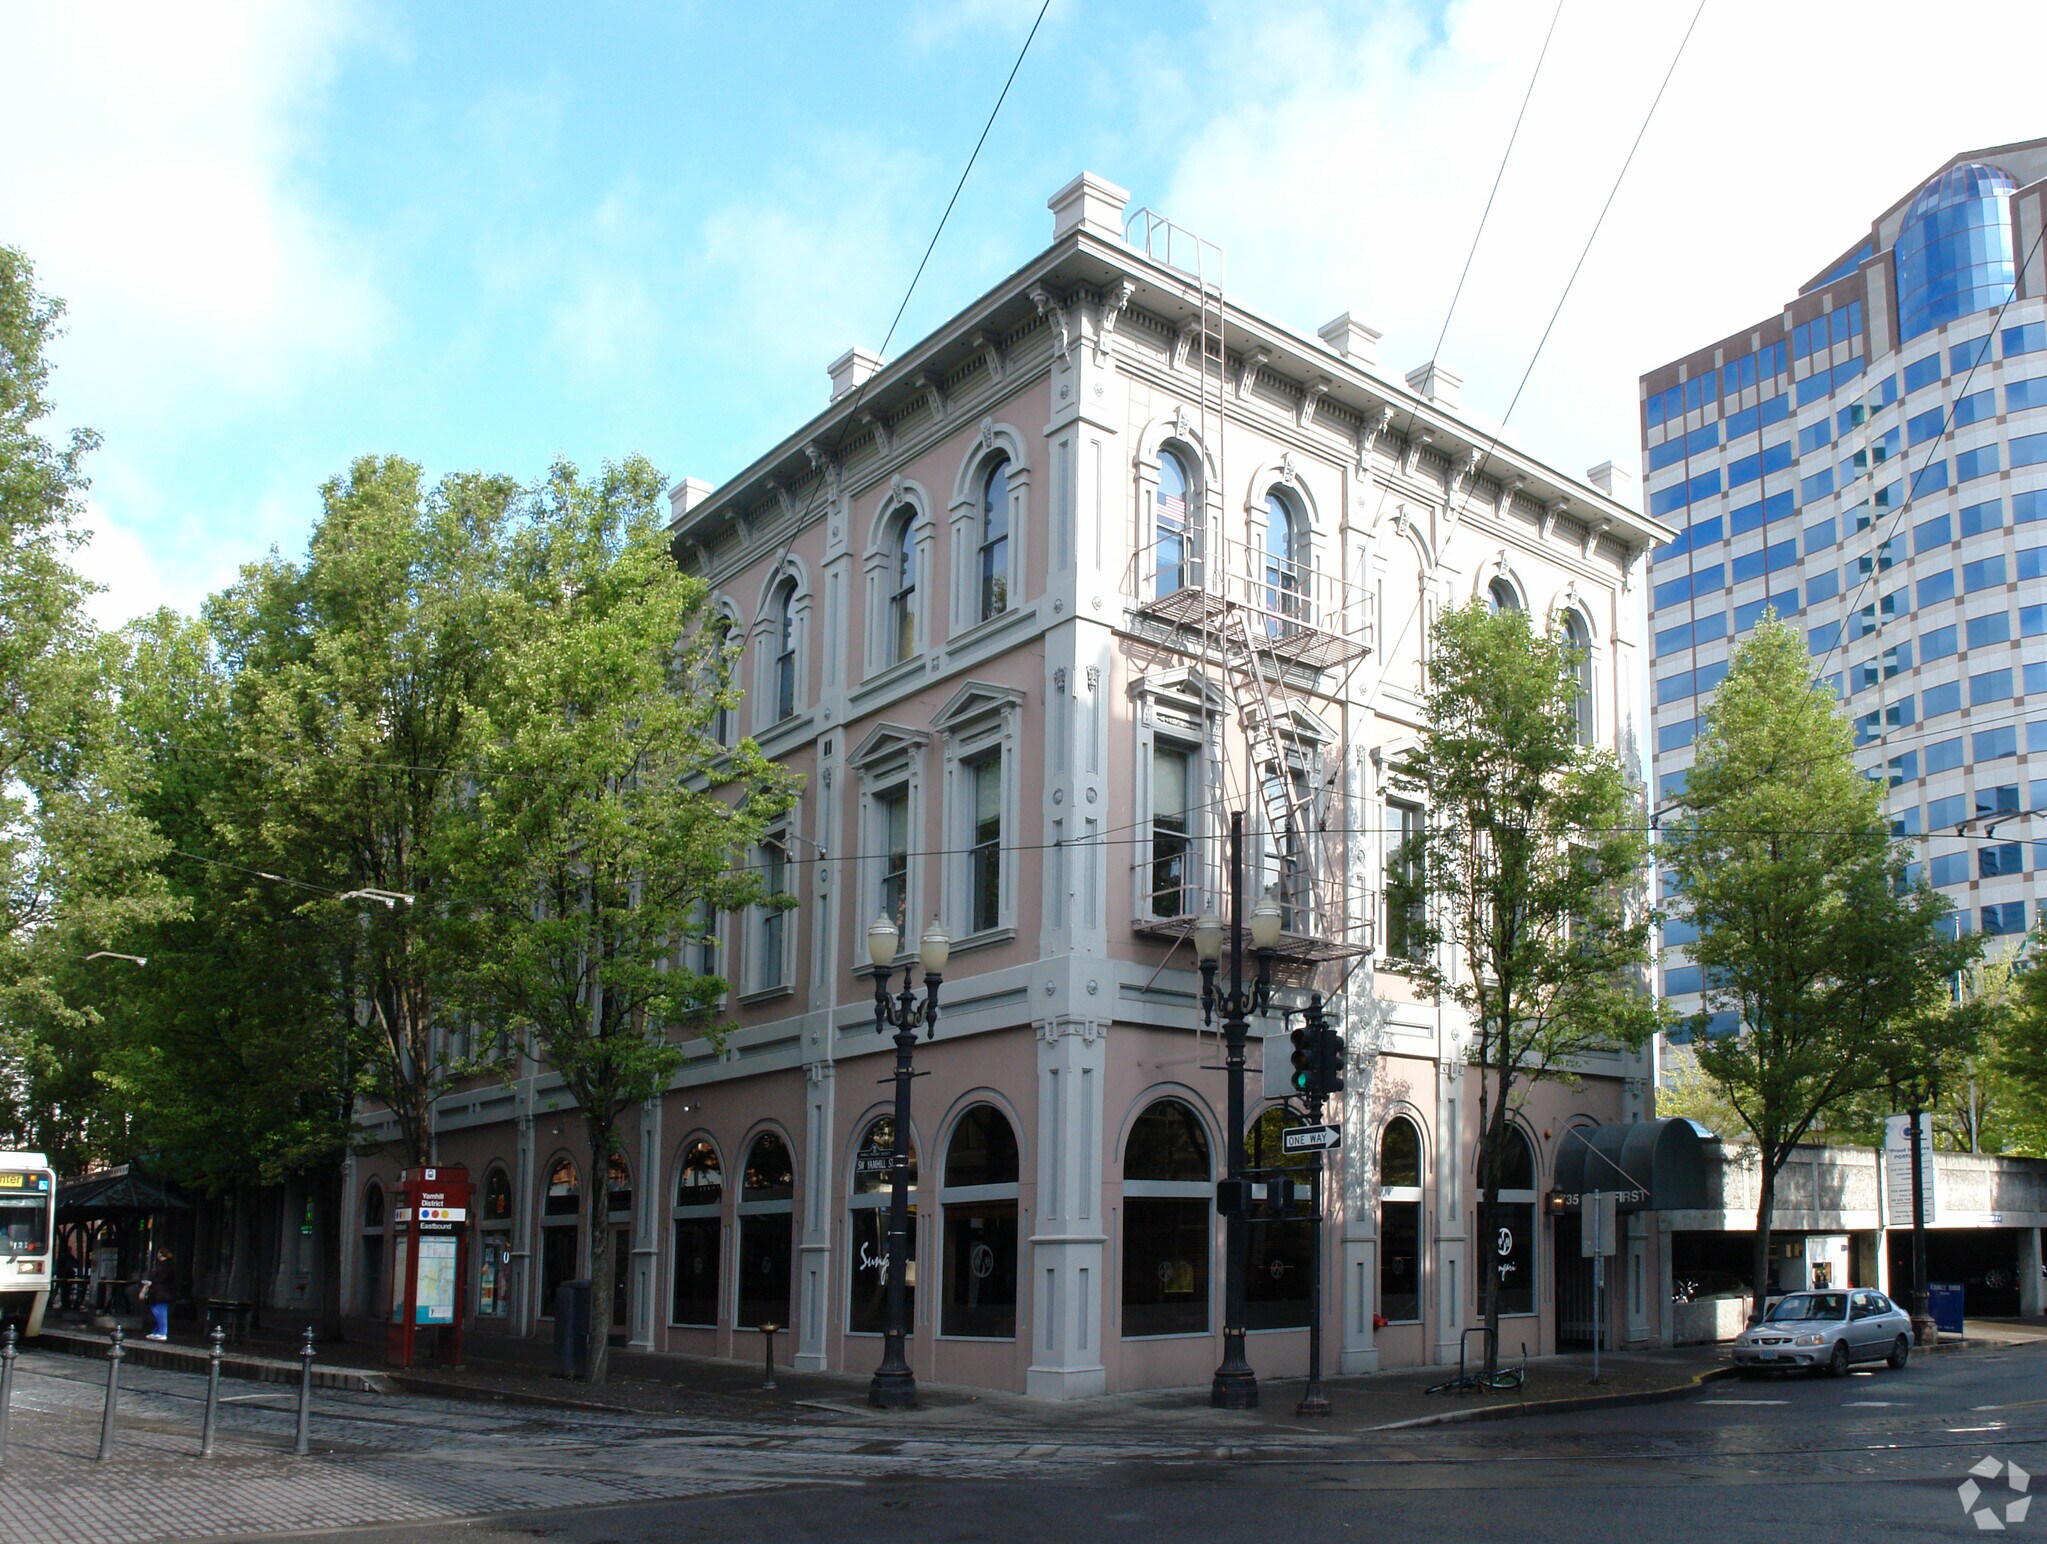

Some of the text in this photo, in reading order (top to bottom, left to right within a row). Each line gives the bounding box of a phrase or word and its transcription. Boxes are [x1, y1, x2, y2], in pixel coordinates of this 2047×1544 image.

[1288, 1133, 1327, 1146] ONE WAY
[857, 1160, 865, 1170] SW
[867, 1159, 886, 1170] YAMHILL
[420, 1222, 452, 1230] Eastbound
[859, 1241, 890, 1286] Sung
